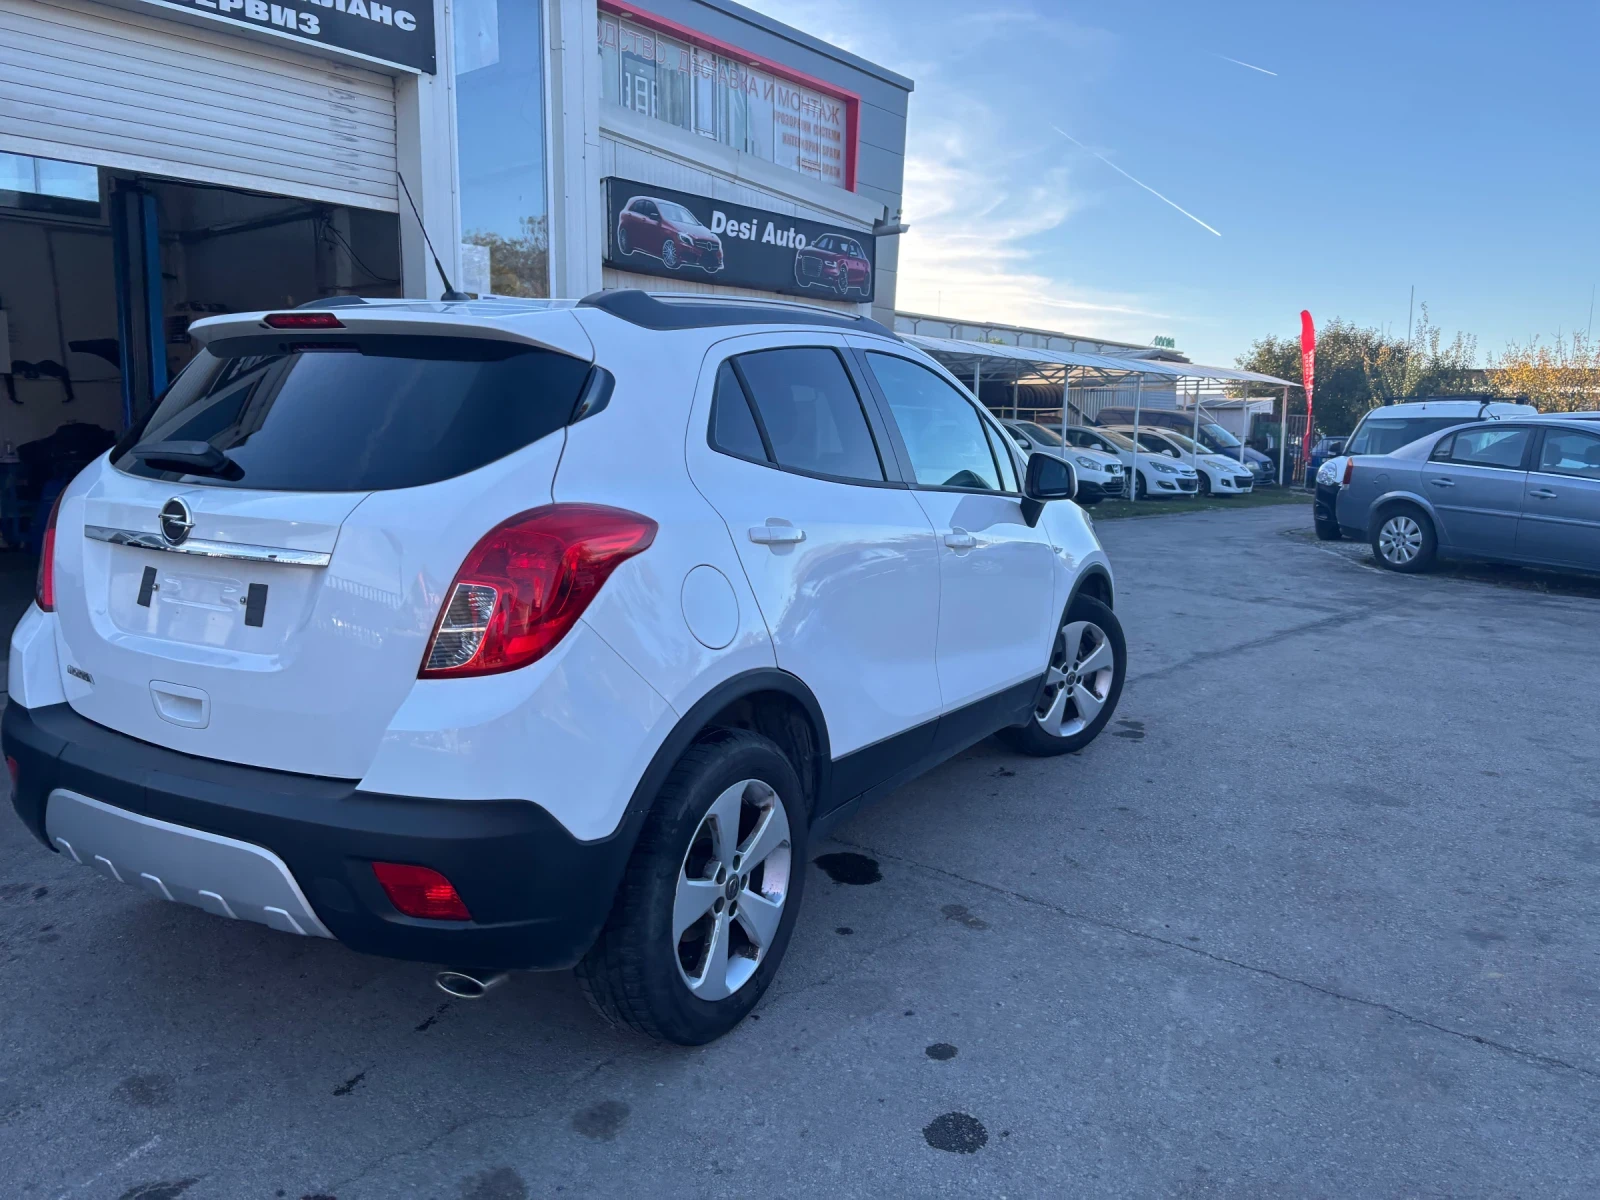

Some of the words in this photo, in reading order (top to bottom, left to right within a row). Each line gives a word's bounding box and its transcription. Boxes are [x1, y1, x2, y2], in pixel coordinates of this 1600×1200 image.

[764, 81, 775, 103] И
[778, 83, 840, 126] МОНТАЖ
[711, 210, 758, 241] Desi
[761, 221, 807, 250] Auto
